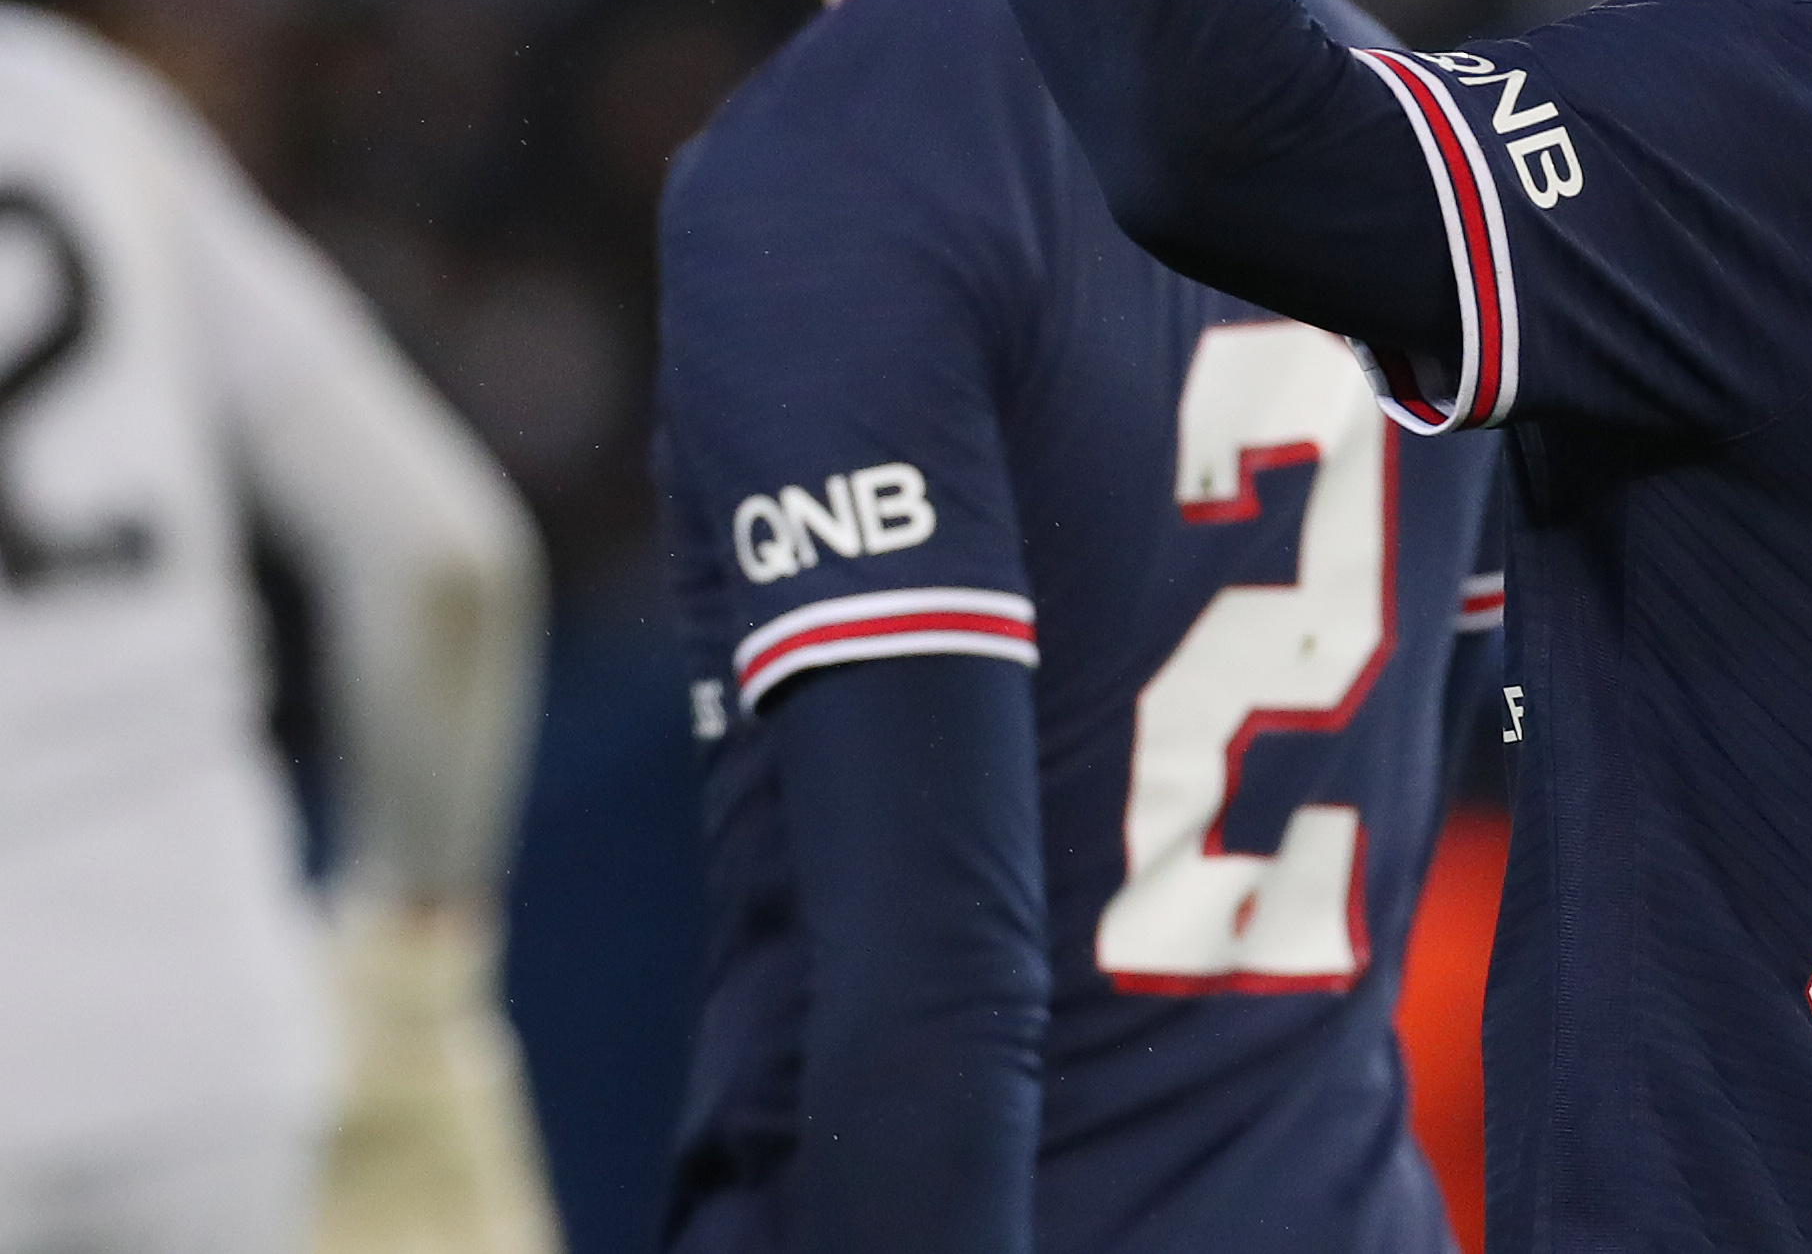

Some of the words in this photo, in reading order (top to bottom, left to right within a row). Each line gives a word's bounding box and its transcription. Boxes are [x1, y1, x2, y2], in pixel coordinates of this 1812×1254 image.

[1411, 51, 1585, 210] QNB
[732, 460, 938, 584] QNB
[1096, 319, 1397, 994] 2
